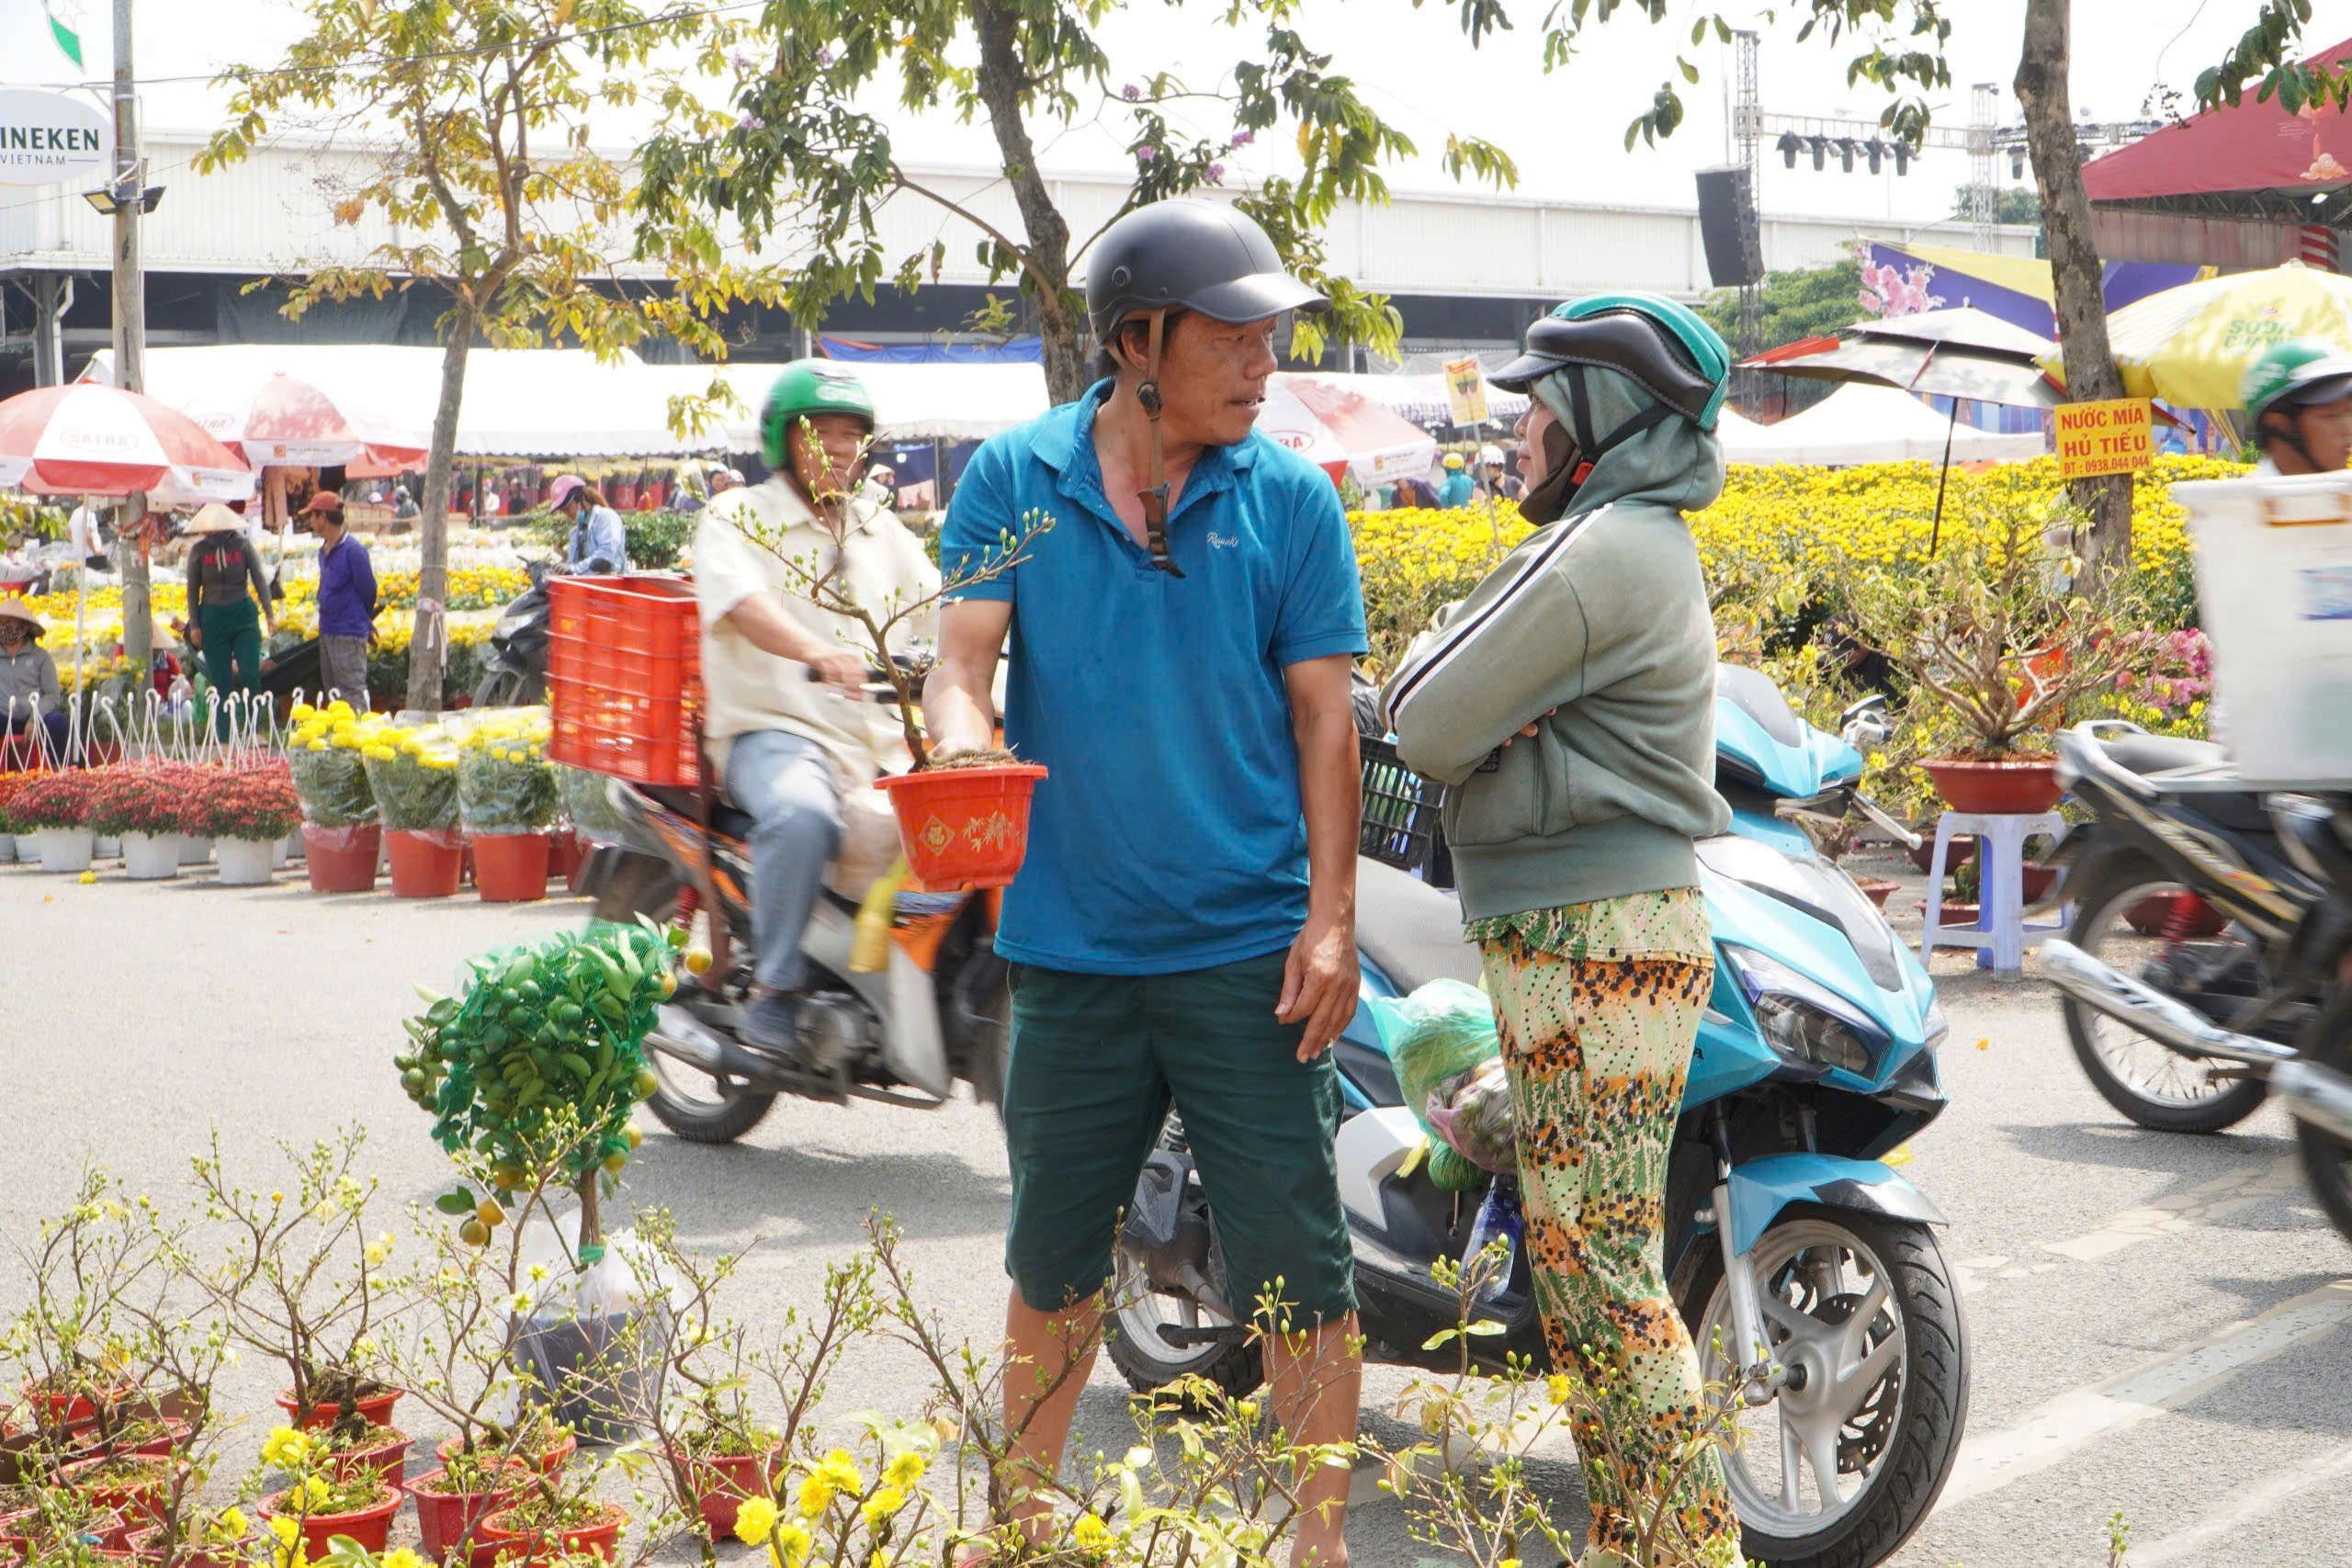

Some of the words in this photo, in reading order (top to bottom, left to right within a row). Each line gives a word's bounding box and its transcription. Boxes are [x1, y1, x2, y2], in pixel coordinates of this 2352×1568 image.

[1, 154, 65, 164] VIETNAM
[2061, 406, 2108, 430] NƯỚC
[2113, 403, 2144, 425] MÍA
[2064, 434, 2091, 457] HỦ
[2099, 428, 2146, 455] TIẾU
[2085, 457, 2129, 473] 0938.044
[2132, 455, 2149, 468] 044
